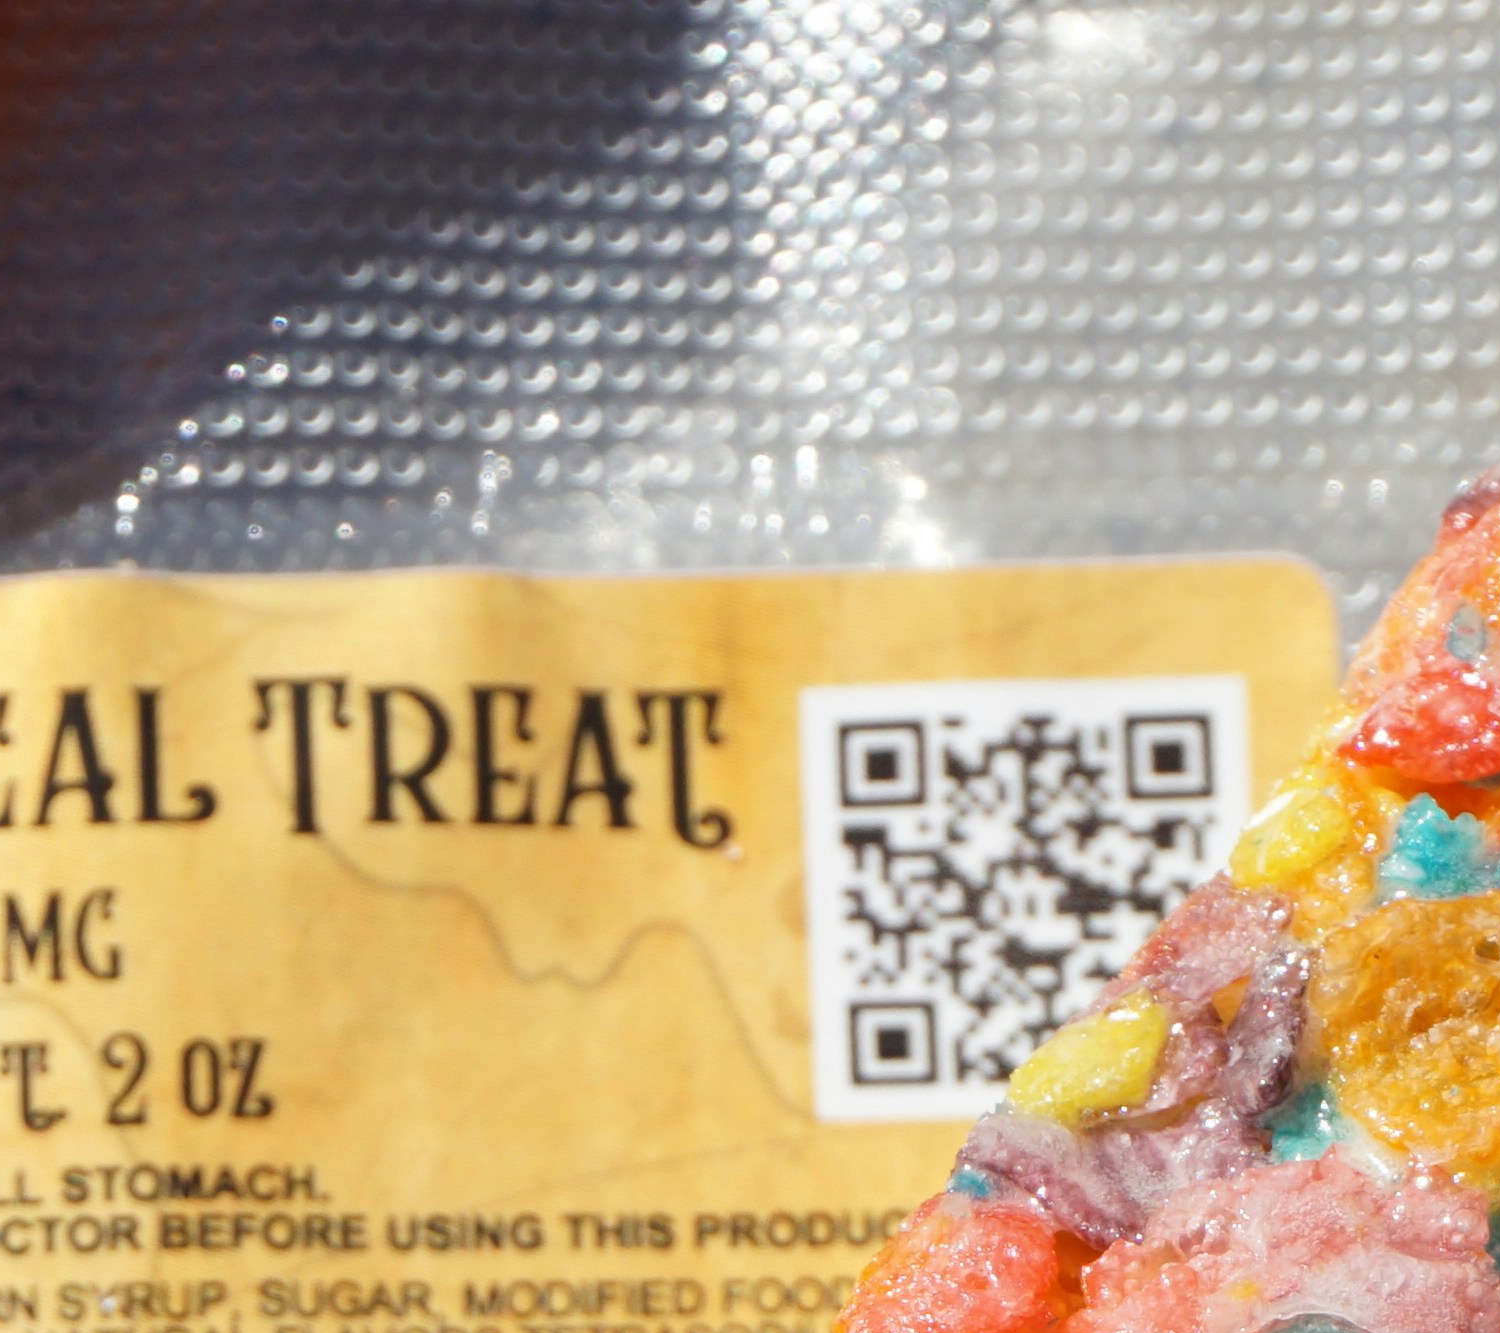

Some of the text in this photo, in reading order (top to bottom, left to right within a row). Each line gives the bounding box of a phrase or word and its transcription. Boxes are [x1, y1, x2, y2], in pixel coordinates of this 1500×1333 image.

[250, 675, 733, 850] TREAT
[2, 888, 122, 984] MG
[100, 1030, 149, 1126] 2
[62, 1162, 330, 1204] STOMACH.
[162, 1212, 367, 1251] BEFORE
[386, 1213, 543, 1251] USING
[565, 1212, 673, 1250] THIS
[460, 1276, 704, 1320] MODIFIED
